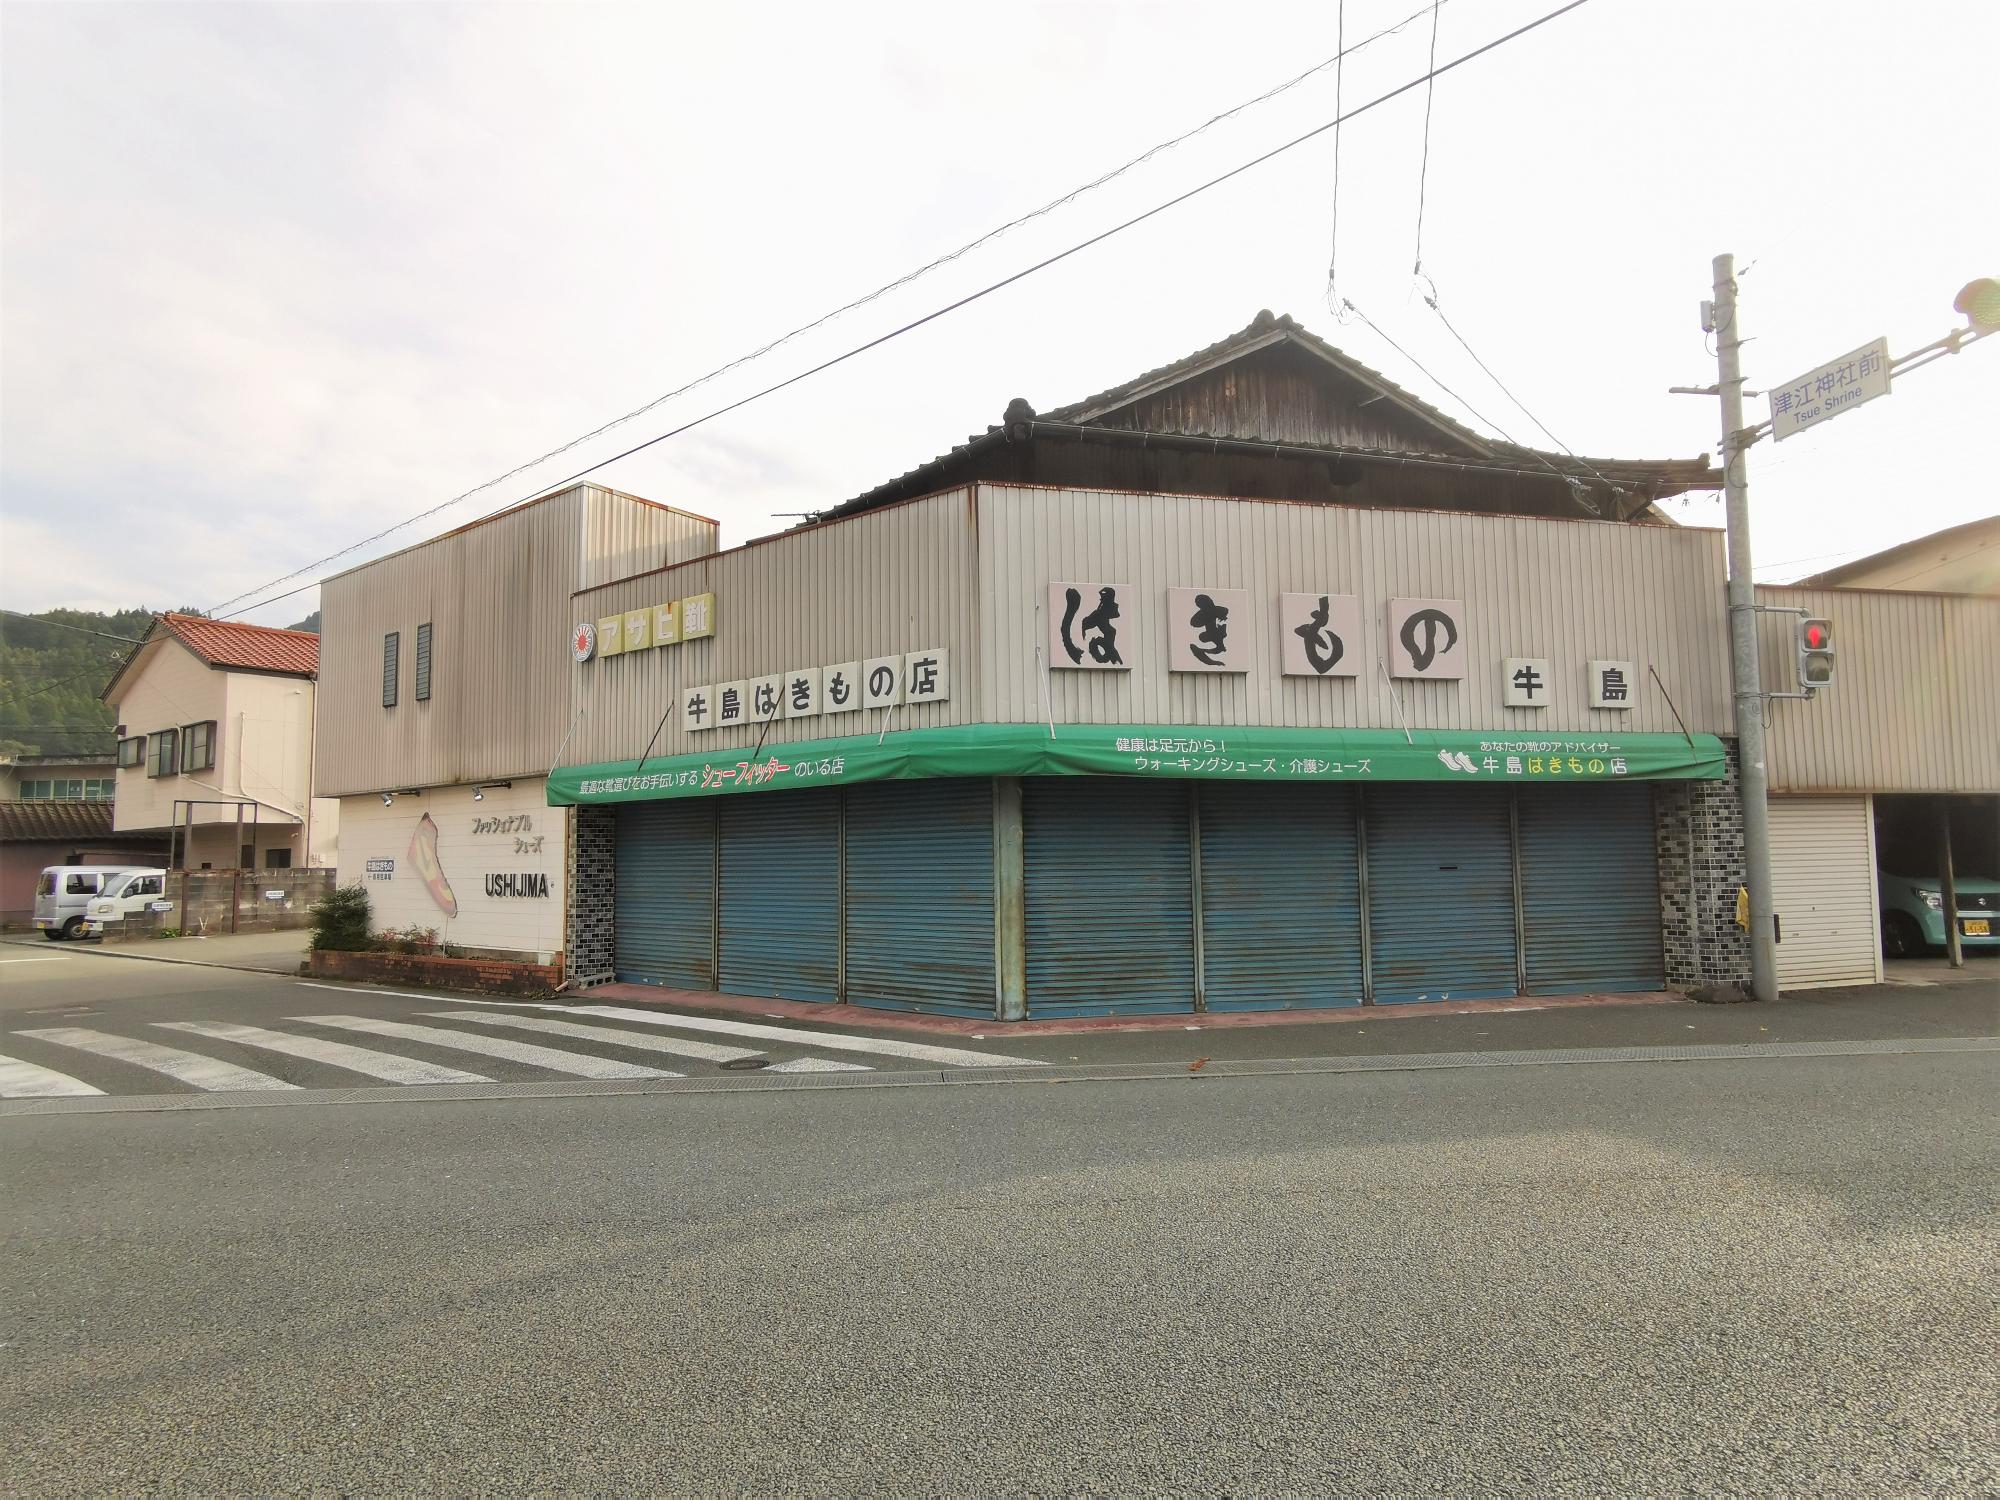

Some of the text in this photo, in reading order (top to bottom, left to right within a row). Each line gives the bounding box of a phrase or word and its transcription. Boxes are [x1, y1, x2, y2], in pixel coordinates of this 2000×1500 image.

[1774, 350, 1881, 417] 津江神社前
[1794, 386, 1863, 424] Tsue Shrine
[600, 603, 707, 652] アサヒ靴
[687, 656, 938, 724] 牛島はきもの店
[1513, 665, 1627, 701] 牛島
[1480, 741, 1621, 753] あなたの靴のアドバイザー
[1483, 756, 1628, 775] 牛島はきもの店
[514, 836, 545, 854] シューズ
[485, 873, 549, 898] USHIJIMA
